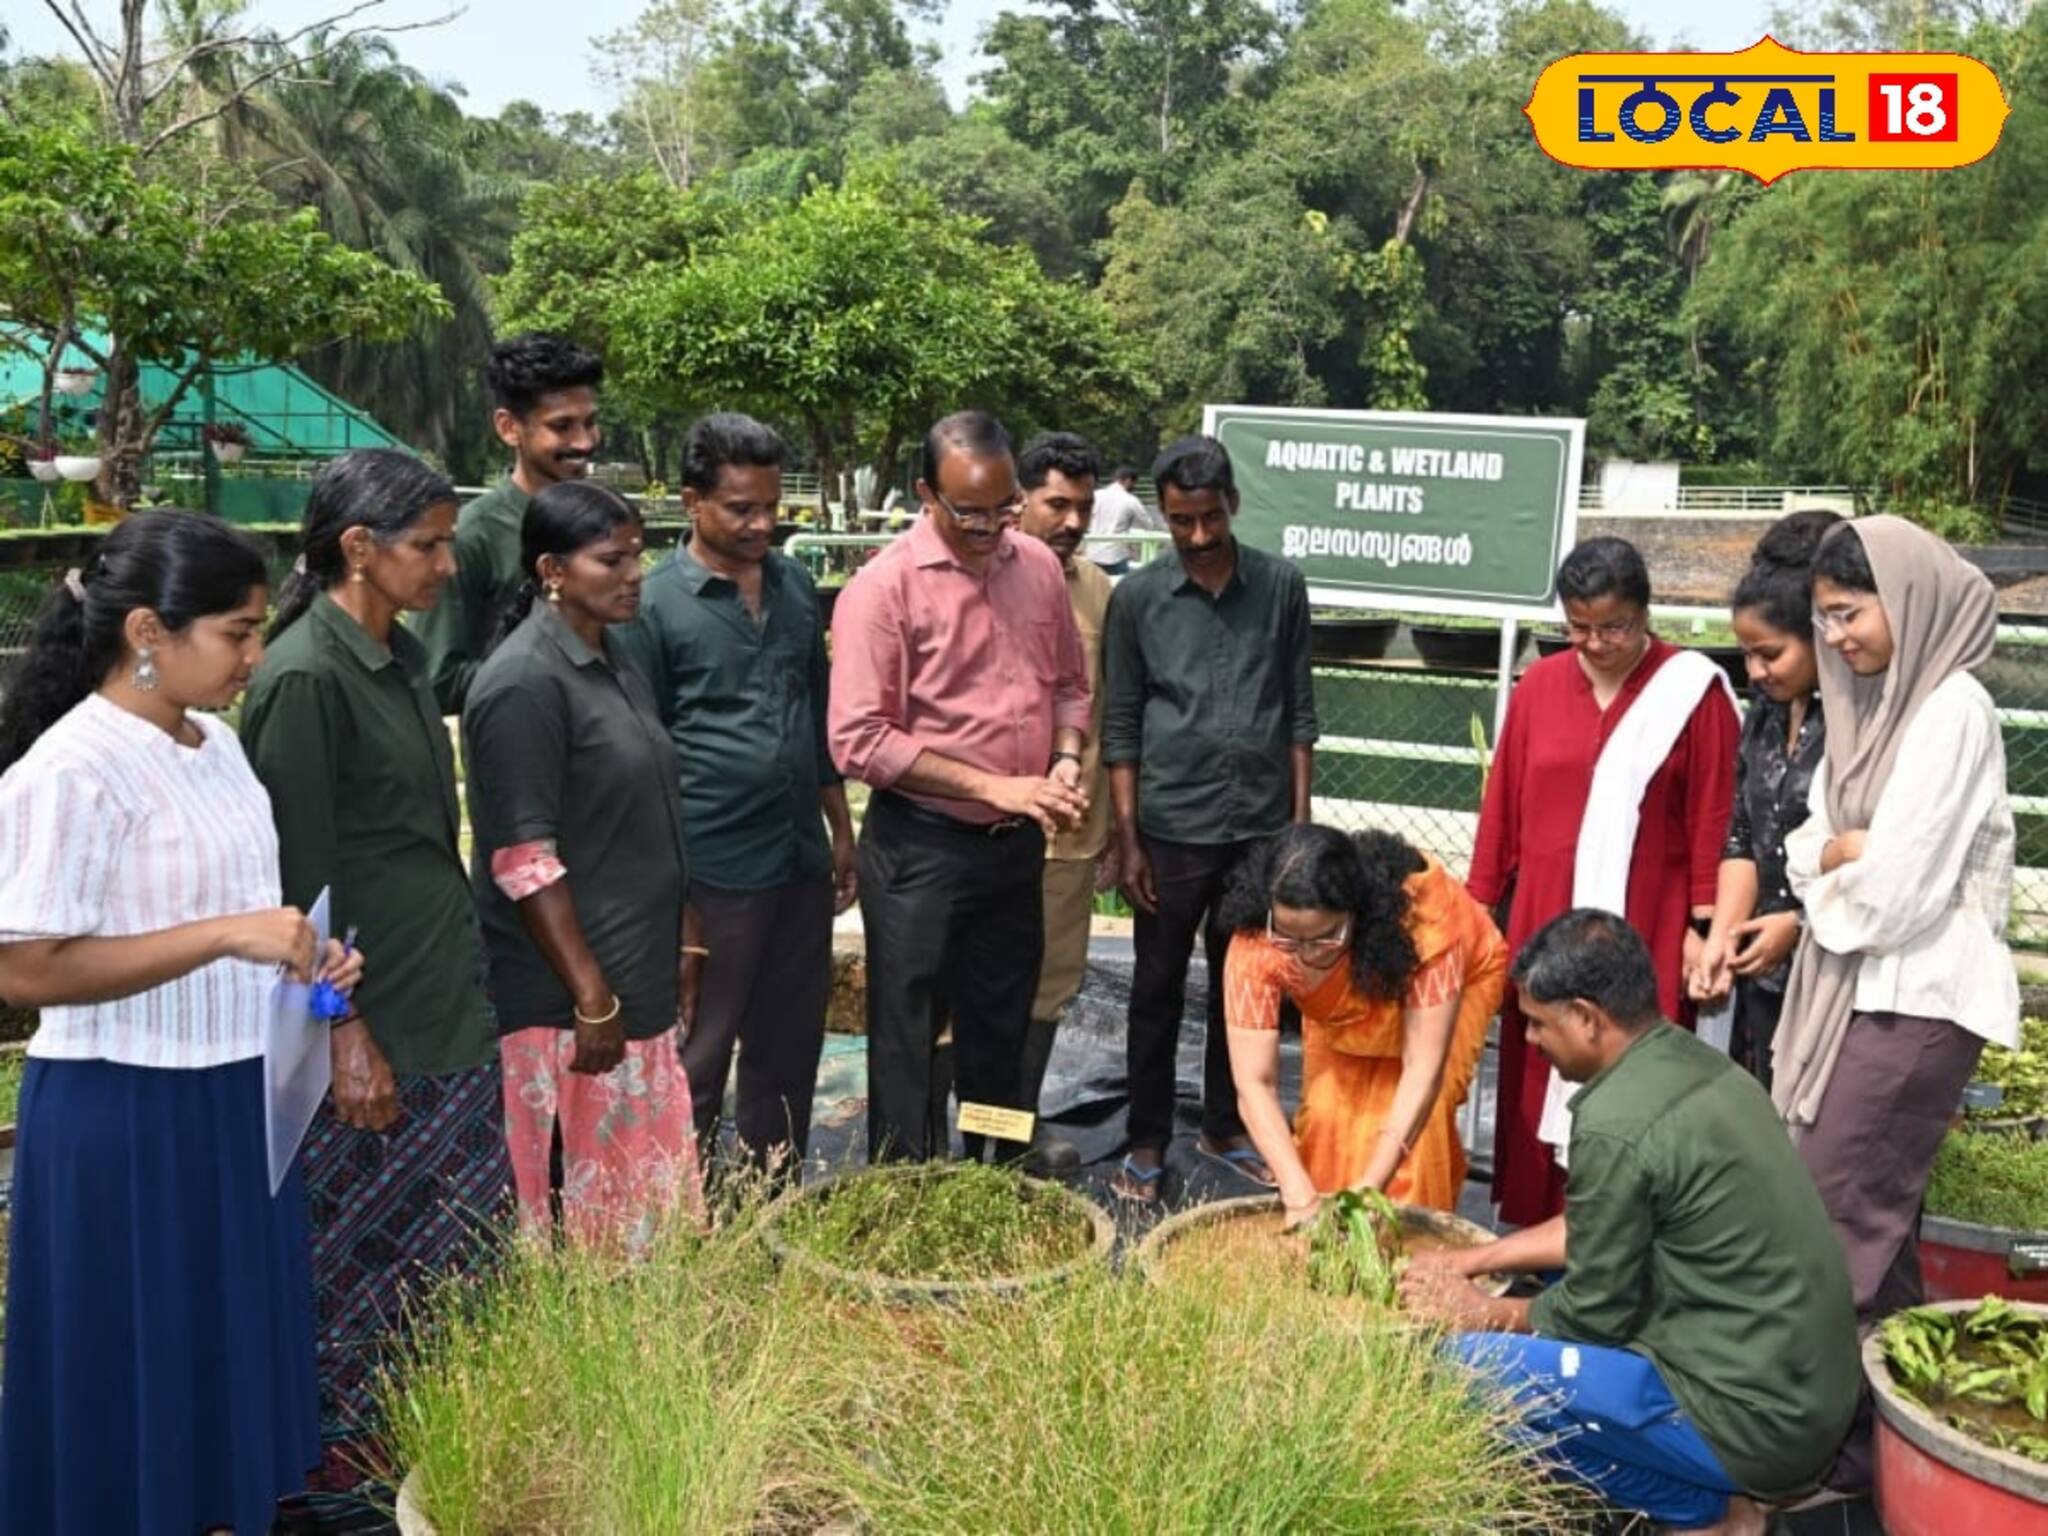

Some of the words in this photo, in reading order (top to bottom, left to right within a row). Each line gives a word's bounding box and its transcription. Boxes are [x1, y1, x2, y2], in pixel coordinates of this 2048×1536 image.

[1265, 440, 1364, 472] AQUATIC
[1368, 450, 1386, 473] &
[1391, 447, 1504, 480] WETLAND
[1335, 482, 1424, 514] PLANTS
